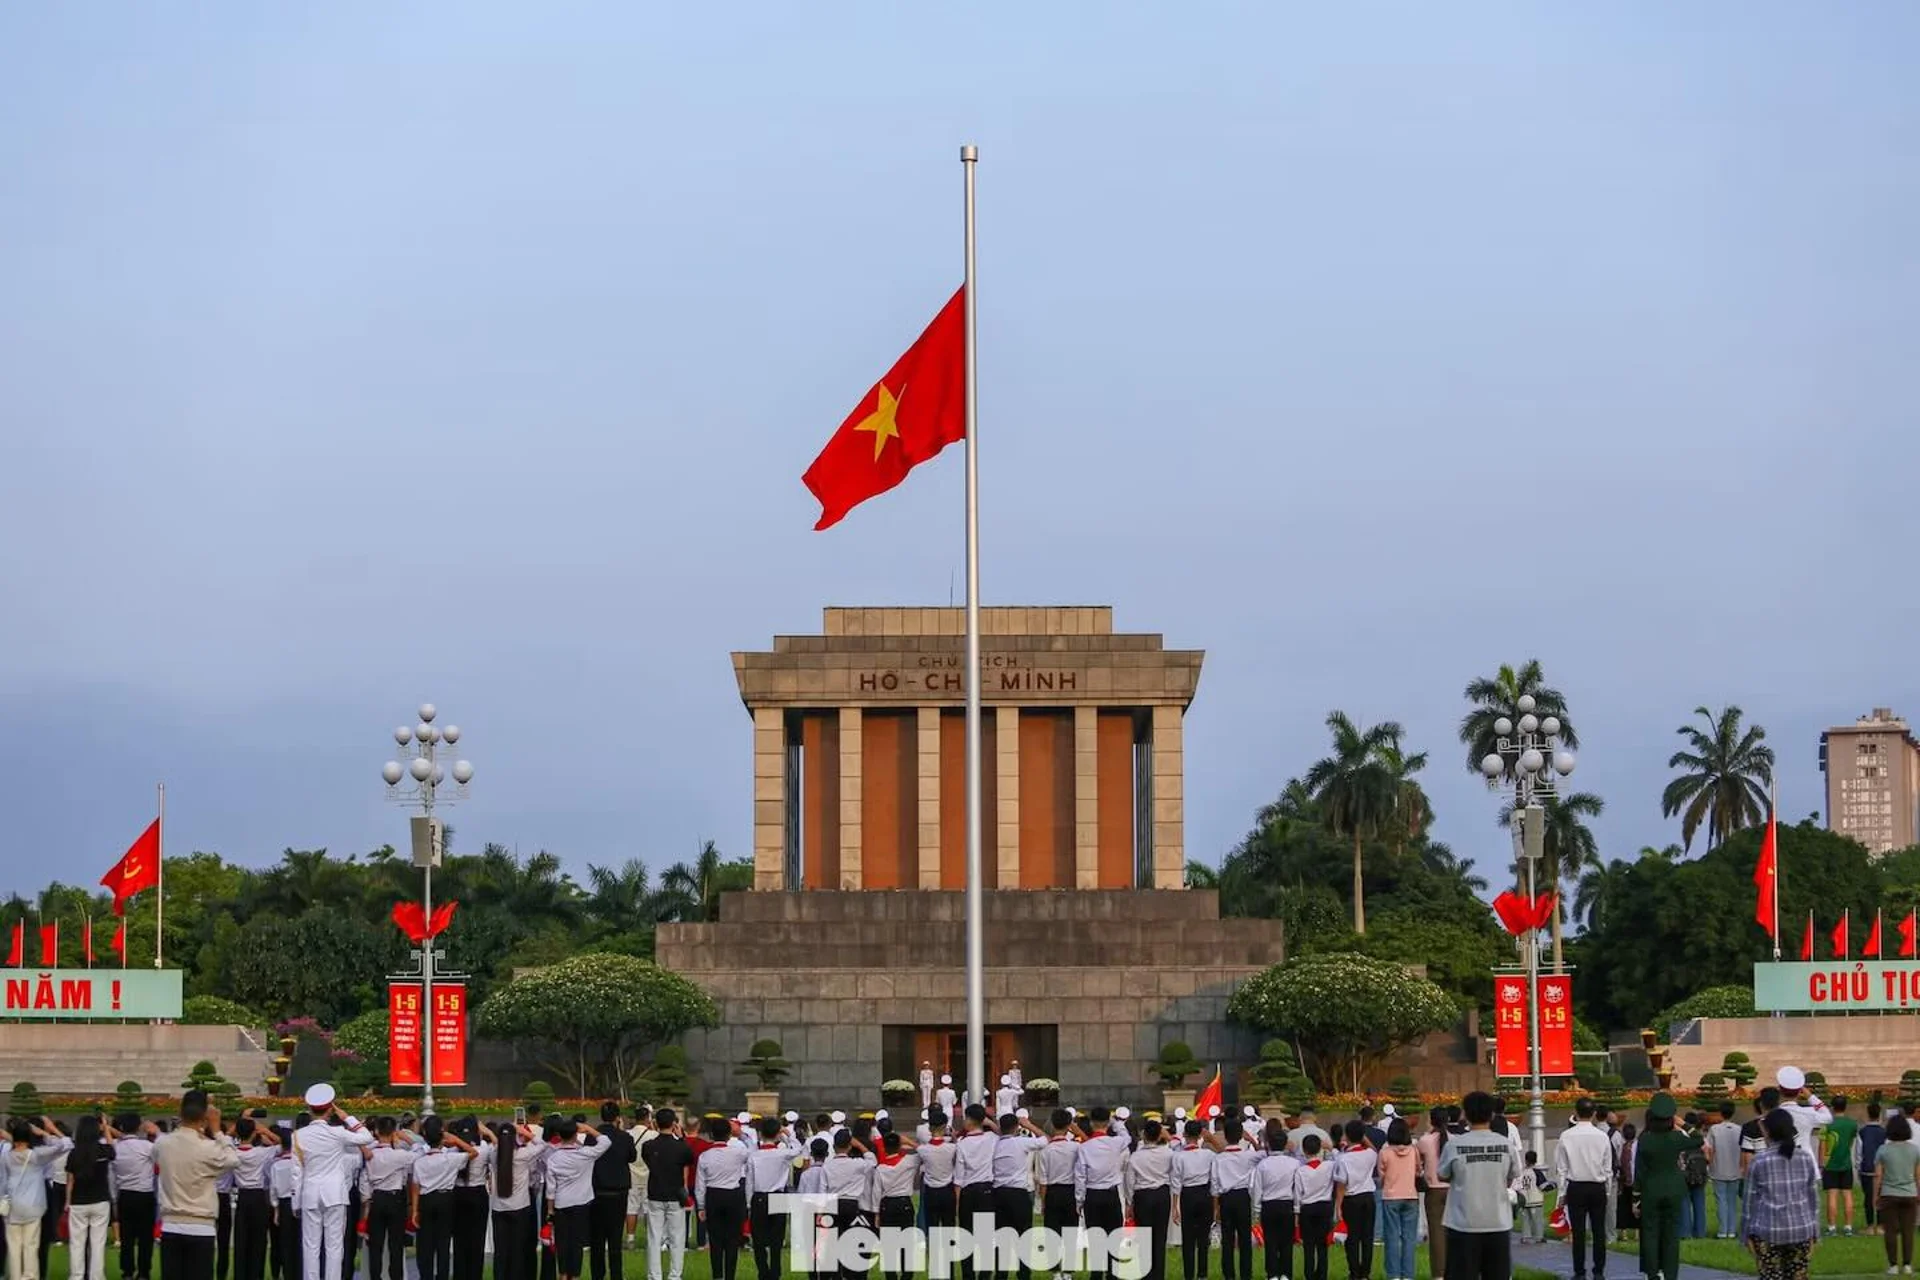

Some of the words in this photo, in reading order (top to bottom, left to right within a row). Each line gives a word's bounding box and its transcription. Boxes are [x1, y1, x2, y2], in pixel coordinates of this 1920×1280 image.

[979, 655, 1018, 671] ỊCH
[925, 673, 961, 691] CH
[1809, 962, 1869, 1002] CHỦ
[6, 973, 92, 1010] NĂM
[395, 993, 416, 1010] 1-5
[437, 994, 459, 1010] 1-5
[1501, 1007, 1522, 1023] 1-5
[1544, 1007, 1566, 1023] 1-5
